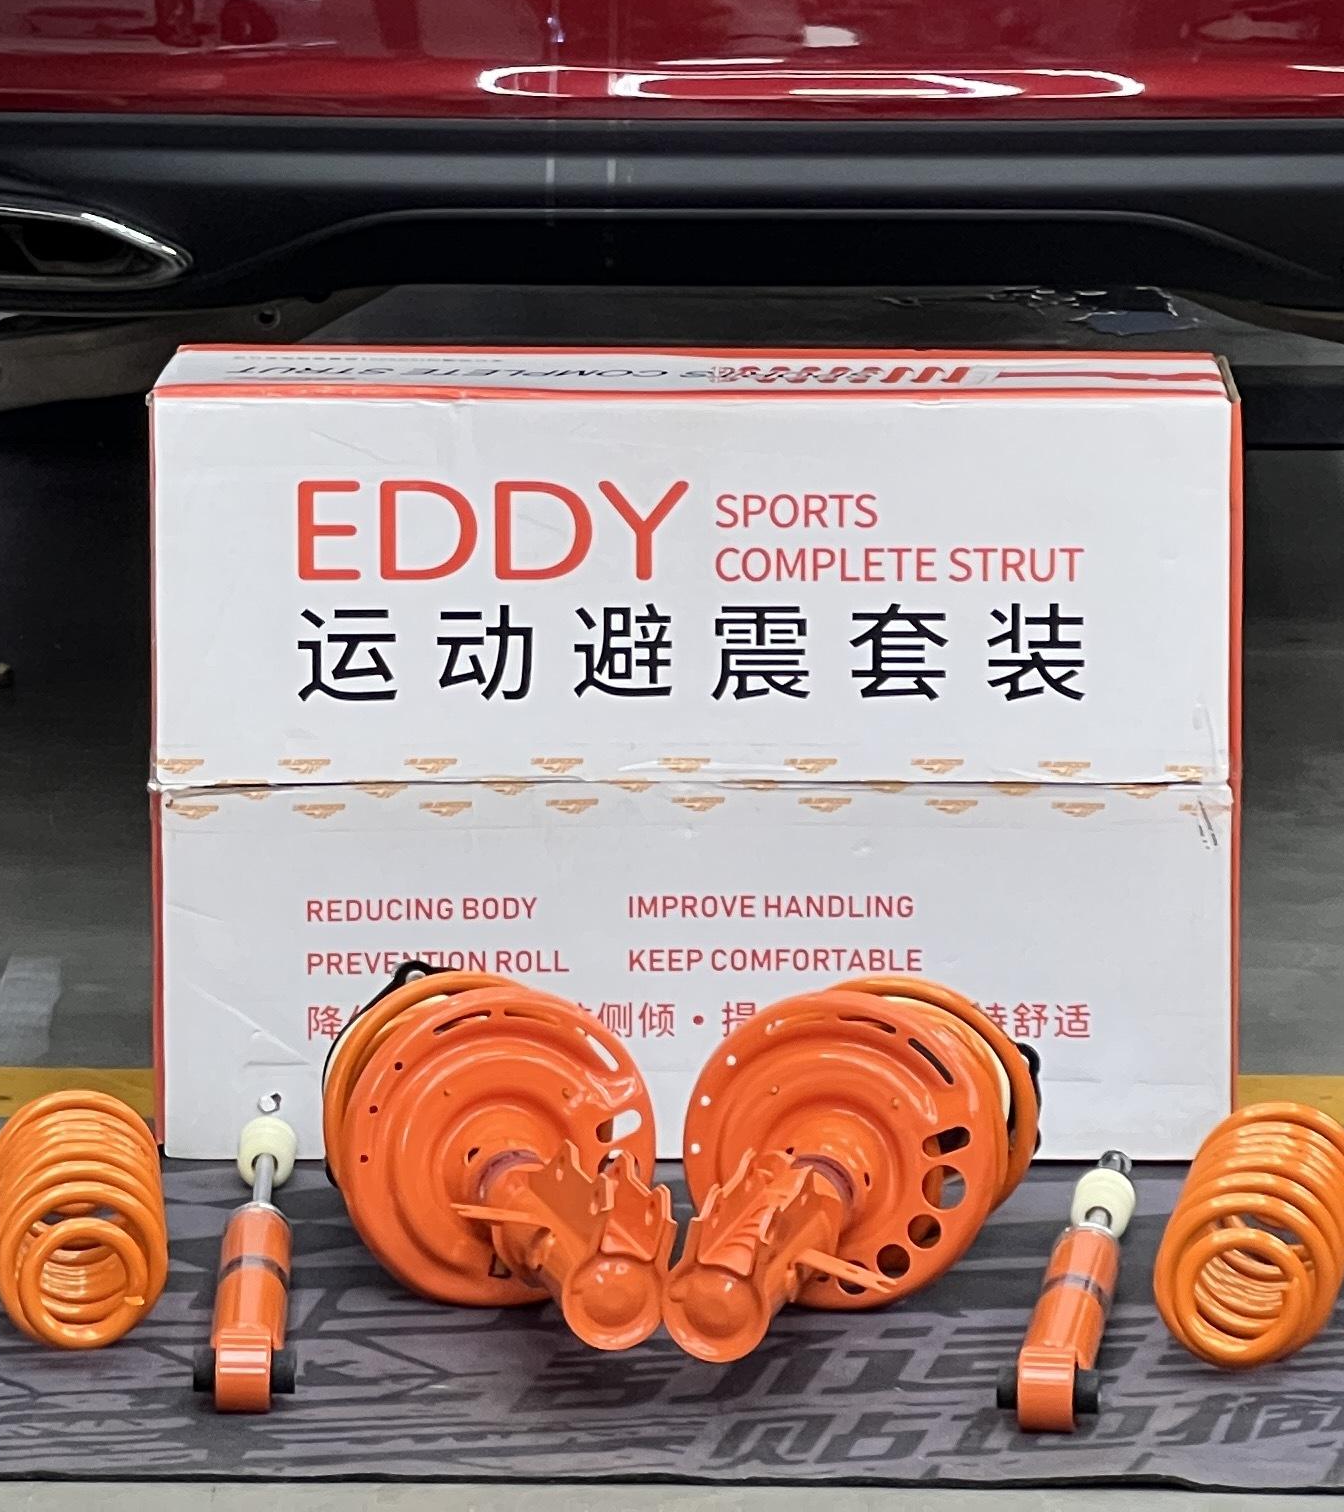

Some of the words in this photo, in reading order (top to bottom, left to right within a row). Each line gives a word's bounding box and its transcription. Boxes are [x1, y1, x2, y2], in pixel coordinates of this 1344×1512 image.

[297, 479, 689, 581] EDDY
[714, 493, 878, 530] SPORTS
[714, 546, 937, 583] COMPLETE
[949, 546, 1084, 583] STRUT
[297, 602, 1087, 702] 运动避震套装
[306, 898, 454, 922] REDUCING
[462, 896, 537, 920] BODY
[627, 895, 756, 918] IMPROVE
[763, 895, 915, 918] HANDLING
[495, 950, 570, 974] ROLL
[628, 949, 703, 972] KEEP
[711, 949, 923, 972] COMFORTABLE
